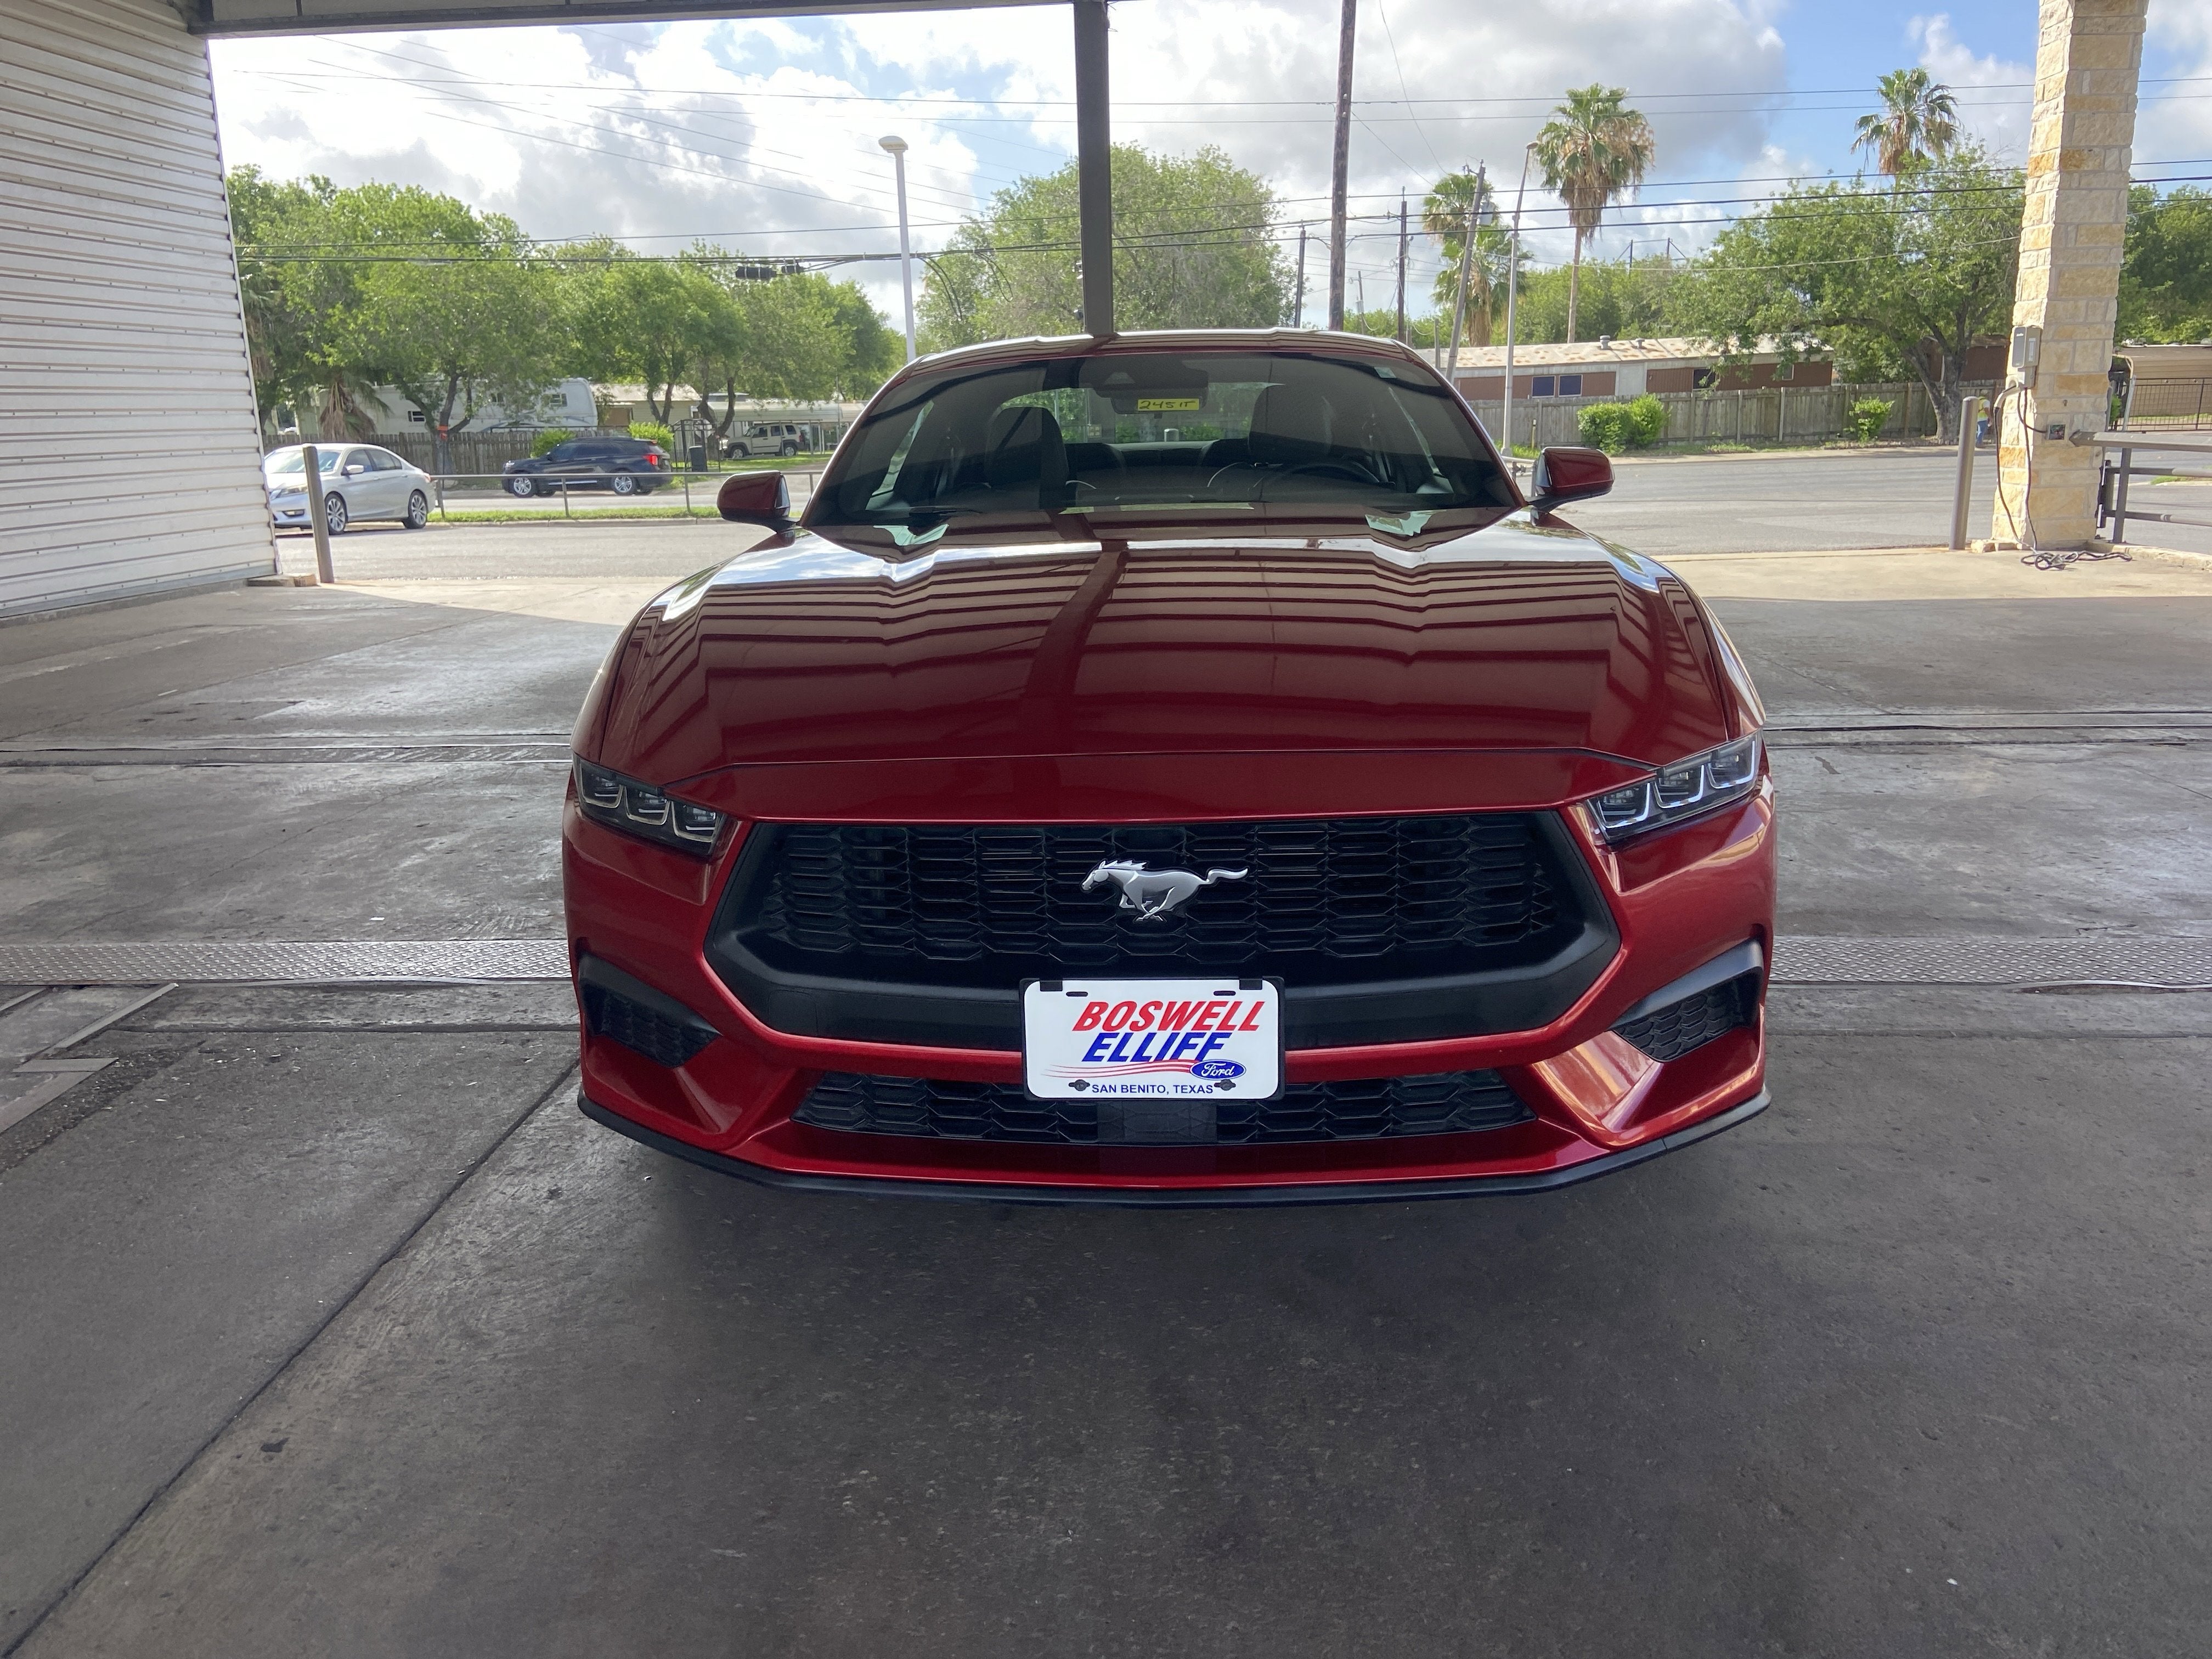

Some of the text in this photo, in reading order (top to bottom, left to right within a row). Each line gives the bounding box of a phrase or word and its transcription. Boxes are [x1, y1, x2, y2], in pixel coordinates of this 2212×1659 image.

[1071, 1000, 1265, 1032] BOSWELL
[1081, 1032, 1233, 1062] ELLIFF
[1201, 1063, 1235, 1077] Ford
[1092, 1084, 1214, 1095] SAN BENITO, TEXAS
